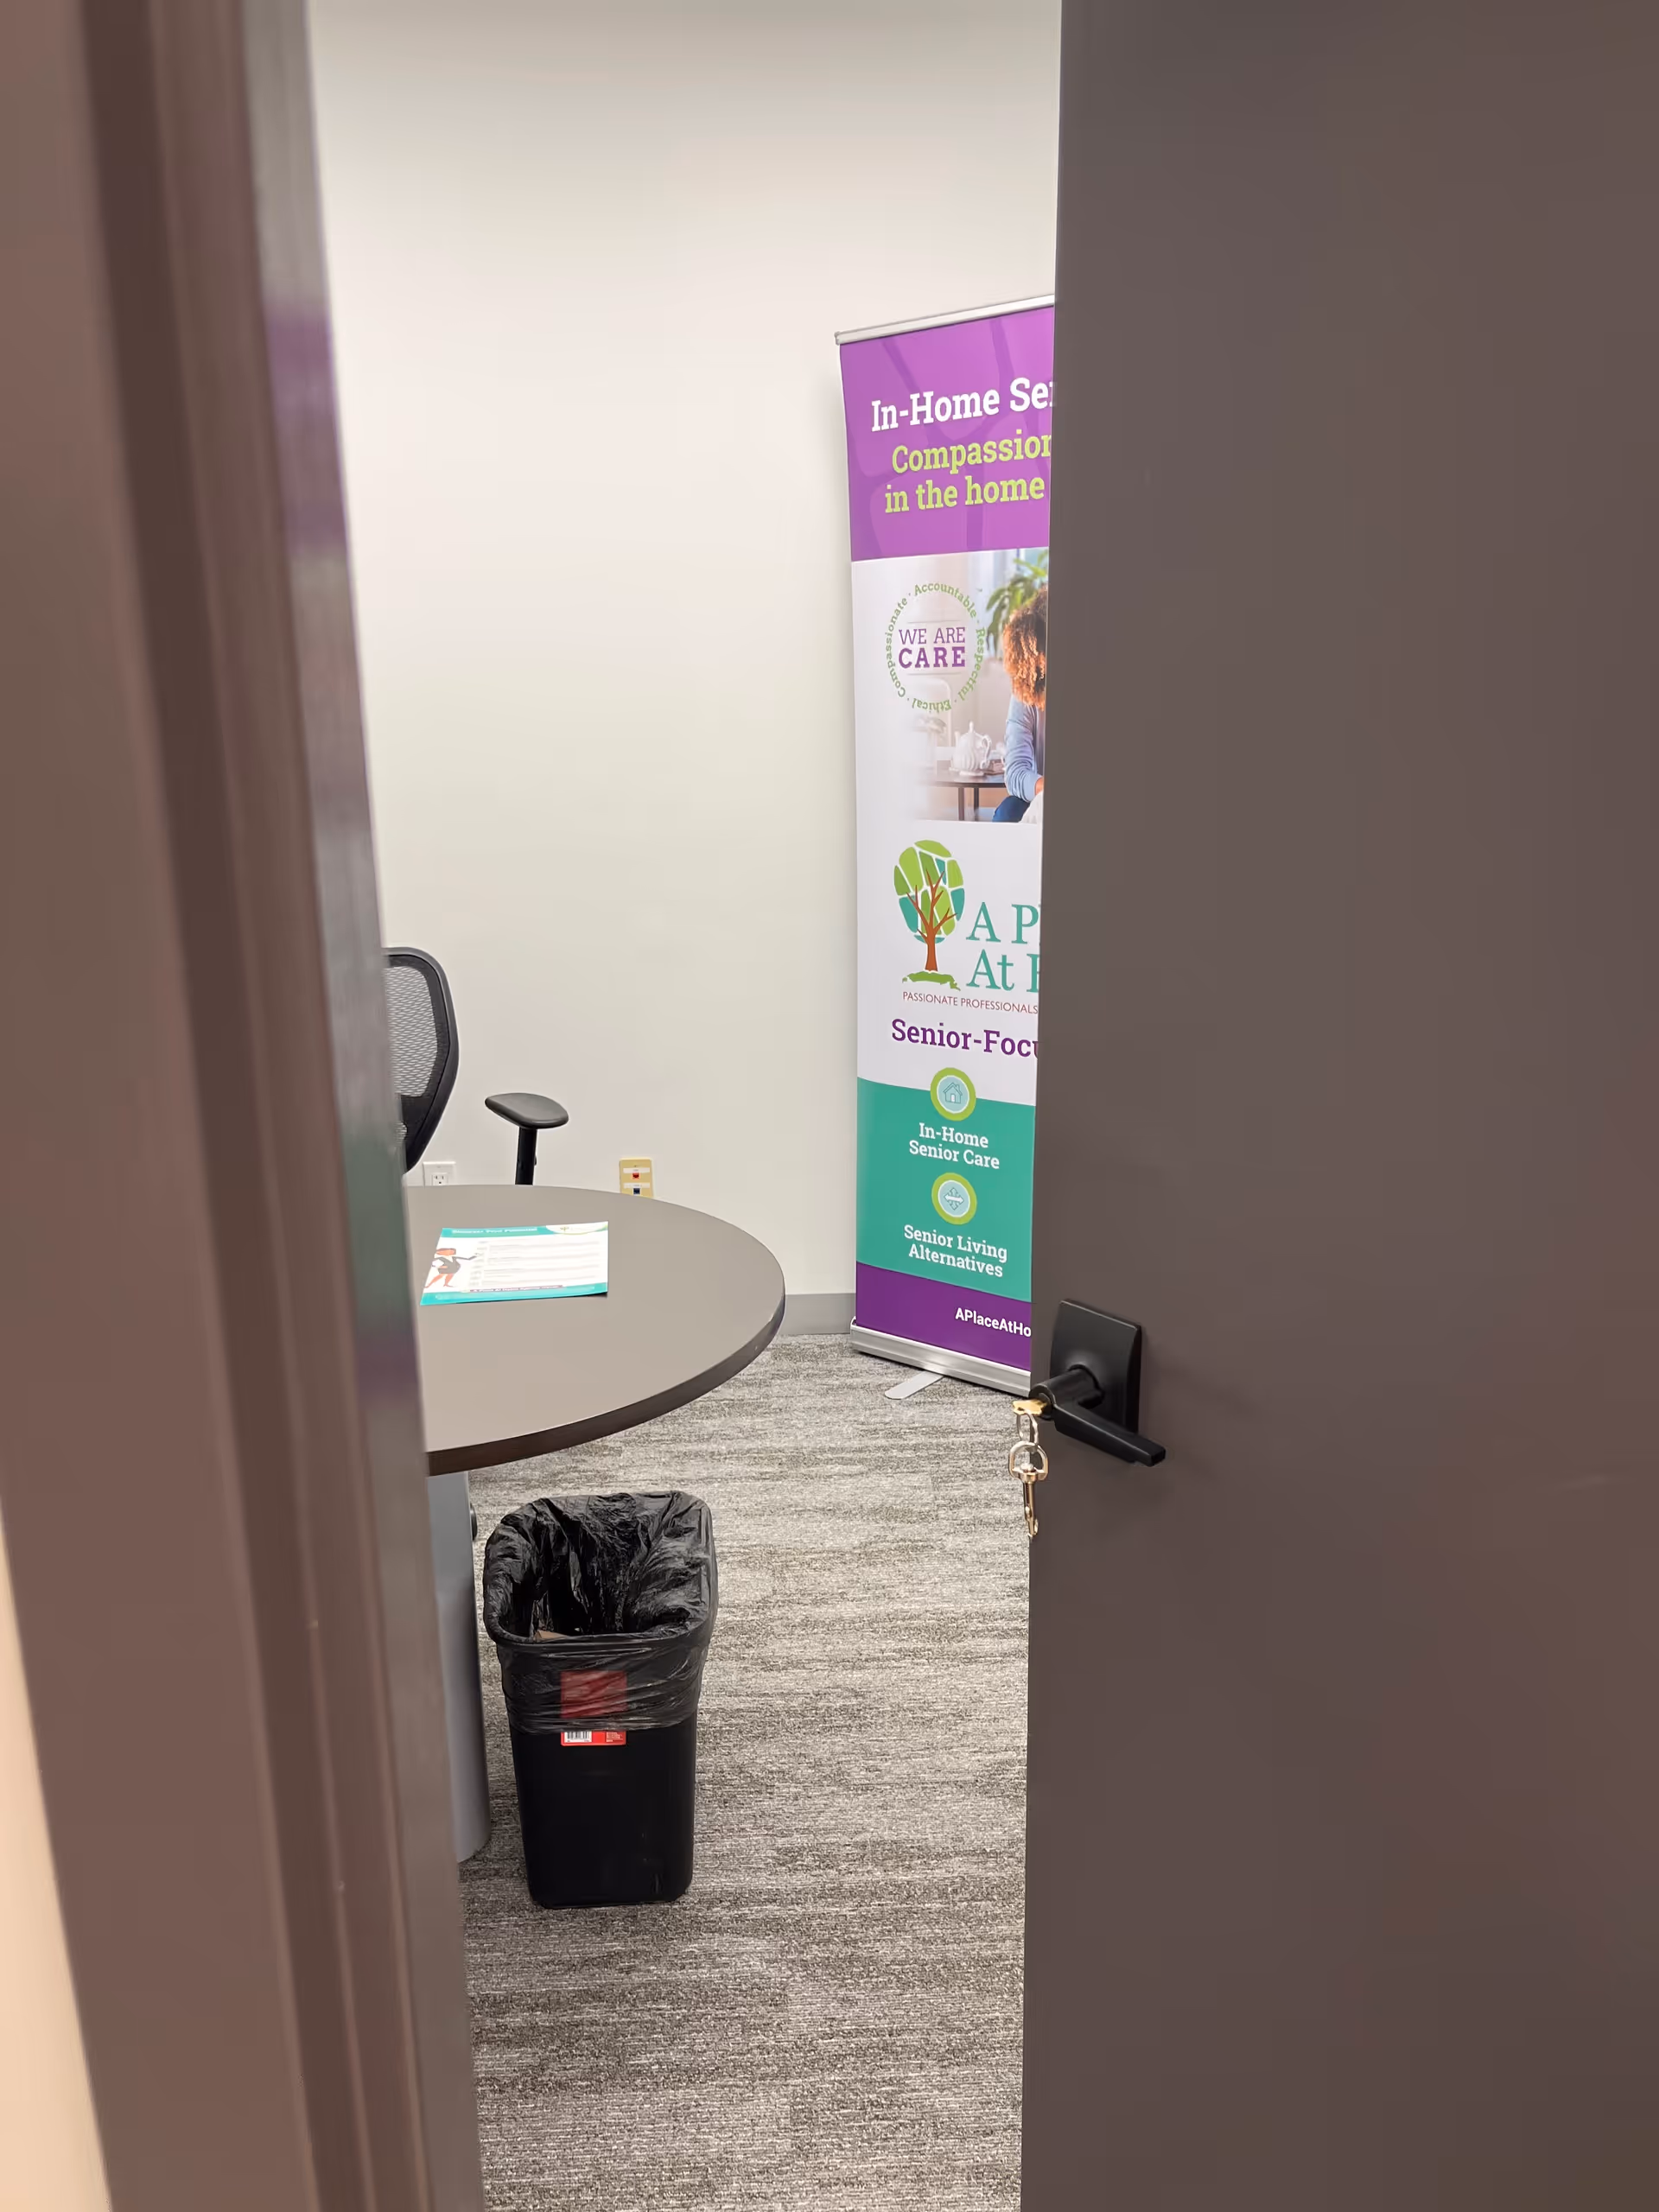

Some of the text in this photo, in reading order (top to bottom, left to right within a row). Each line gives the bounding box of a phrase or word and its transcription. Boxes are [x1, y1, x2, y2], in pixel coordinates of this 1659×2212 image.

[872, 389, 1000, 432] In-Home
[885, 476, 1045, 513] in the home
[885, 582, 985, 713] Accountable Respectful Ethical Compassionate
[899, 627, 965, 645] WE ARE
[899, 646, 965, 669] CARE
[966, 901, 1001, 943] A
[966, 949, 1014, 991] At
[903, 991, 1039, 1014] PASSIONATE PROFESSIONALS
[919, 1122, 988, 1148] In-Home
[909, 1141, 1000, 1169] Senior Care
[904, 1225, 1007, 1263] Senior Living
[908, 1244, 1003, 1277] Alternatives
[955, 1307, 1032, 1337] APlaceAtHo
